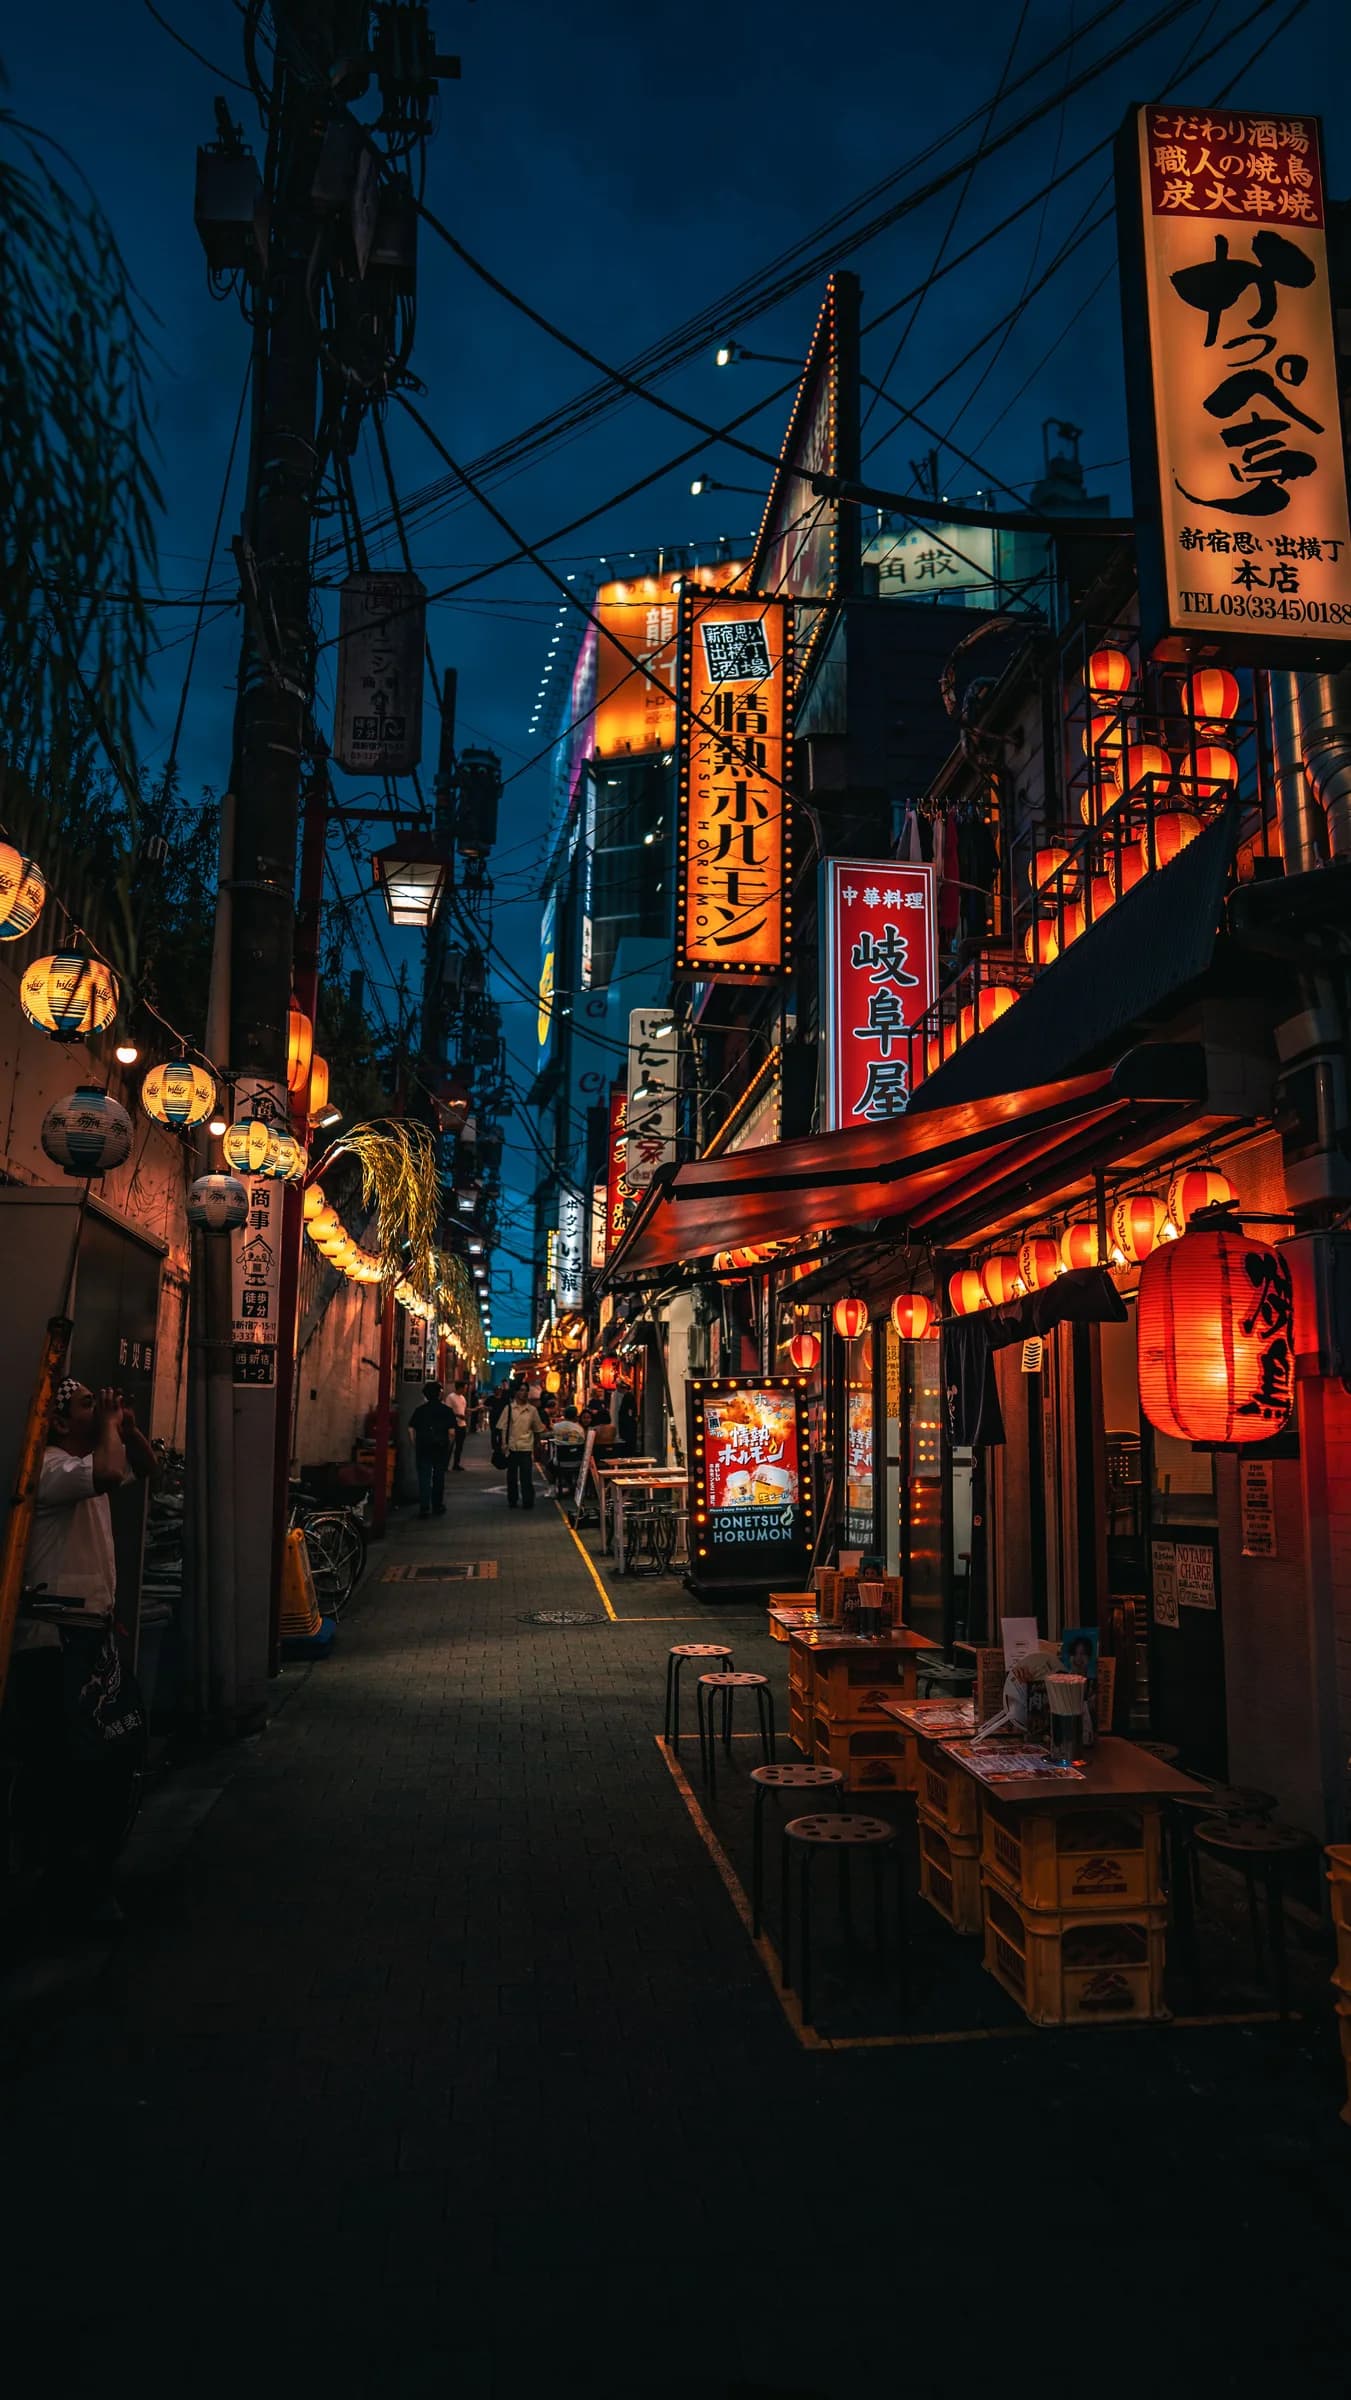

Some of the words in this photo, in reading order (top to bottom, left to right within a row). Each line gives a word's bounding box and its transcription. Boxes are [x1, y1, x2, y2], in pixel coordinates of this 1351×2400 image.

[1152, 120, 1310, 160] こだわり酒場
[1153, 149, 1314, 194] 職人の焼鳥
[1157, 181, 1319, 223] 炭火串焼
[1179, 527, 1344, 565] 新宿思い出横丁
[1231, 560, 1300, 594] 本店
[709, 642, 764, 660] 出横丁
[712, 658, 769, 679] 酒場
[710, 692, 771, 947] 情熱ホルモン
[695, 820, 712, 948] HORUMON
[842, 885, 925, 909] 中華料理
[851, 923, 920, 1121] 岐阜屋
[240, 1368, 265, 1380] 1-2
[731, 1424, 771, 1449] 情熱
[718, 1441, 784, 1466] ホルモン
[713, 1513, 779, 1528] JONETSU
[714, 1526, 792, 1543] HORUMON
[1180, 1563, 1212, 1581] CHARGE
